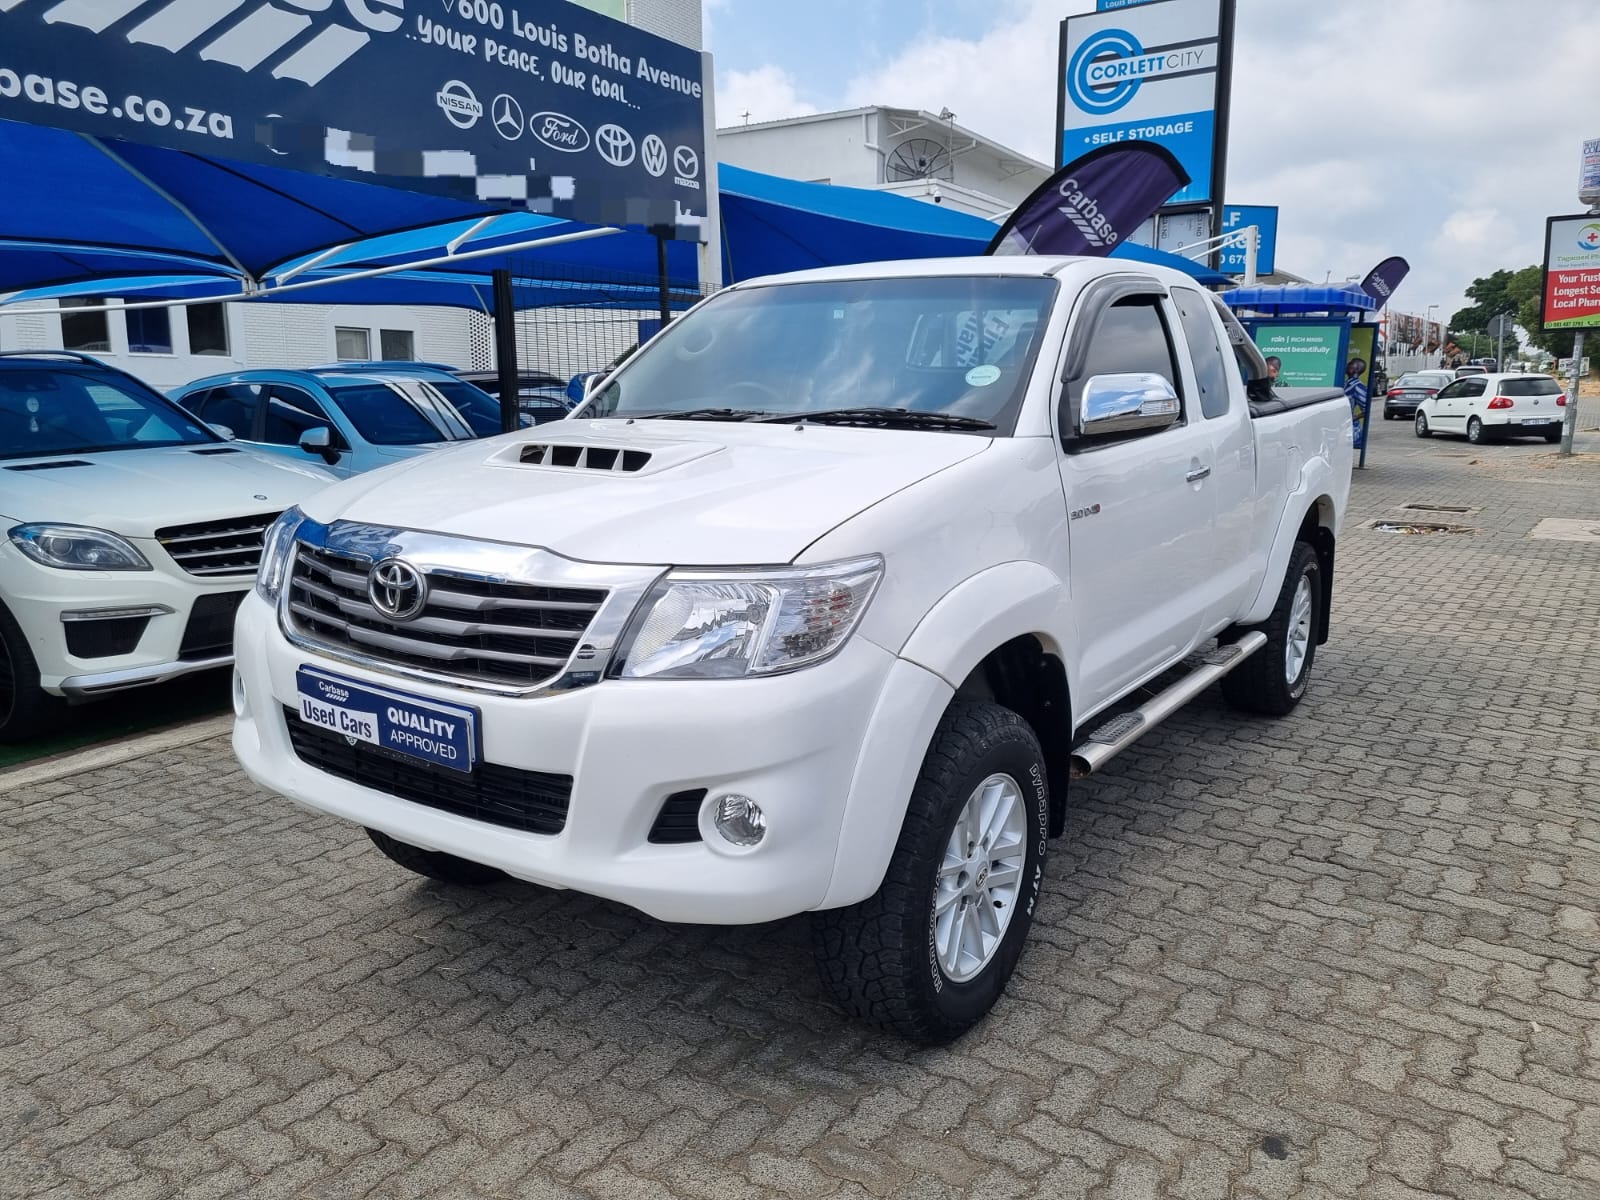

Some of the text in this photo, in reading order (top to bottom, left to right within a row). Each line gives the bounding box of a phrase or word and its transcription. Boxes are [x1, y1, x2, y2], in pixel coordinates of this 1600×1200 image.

[458, 0, 702, 98] 600 Louis Botha Avenue
[551, 61, 587, 91] OUR
[439, 94, 481, 114] NISSAN
[541, 117, 579, 147] Ford
[1092, 121, 1194, 145] SELF STORAGE
[1058, 178, 1119, 246] Carbase
[1559, 274, 1578, 284] Your
[1553, 298, 1576, 308] Local
[1554, 286, 1589, 297] Longest
[1271, 335, 1285, 343] rain
[1291, 346, 1331, 354] beautifully
[319, 681, 350, 698] Carbase
[303, 699, 372, 739] Used Cars
[387, 706, 456, 740] QUALITY
[390, 729, 457, 760] APPROVED
